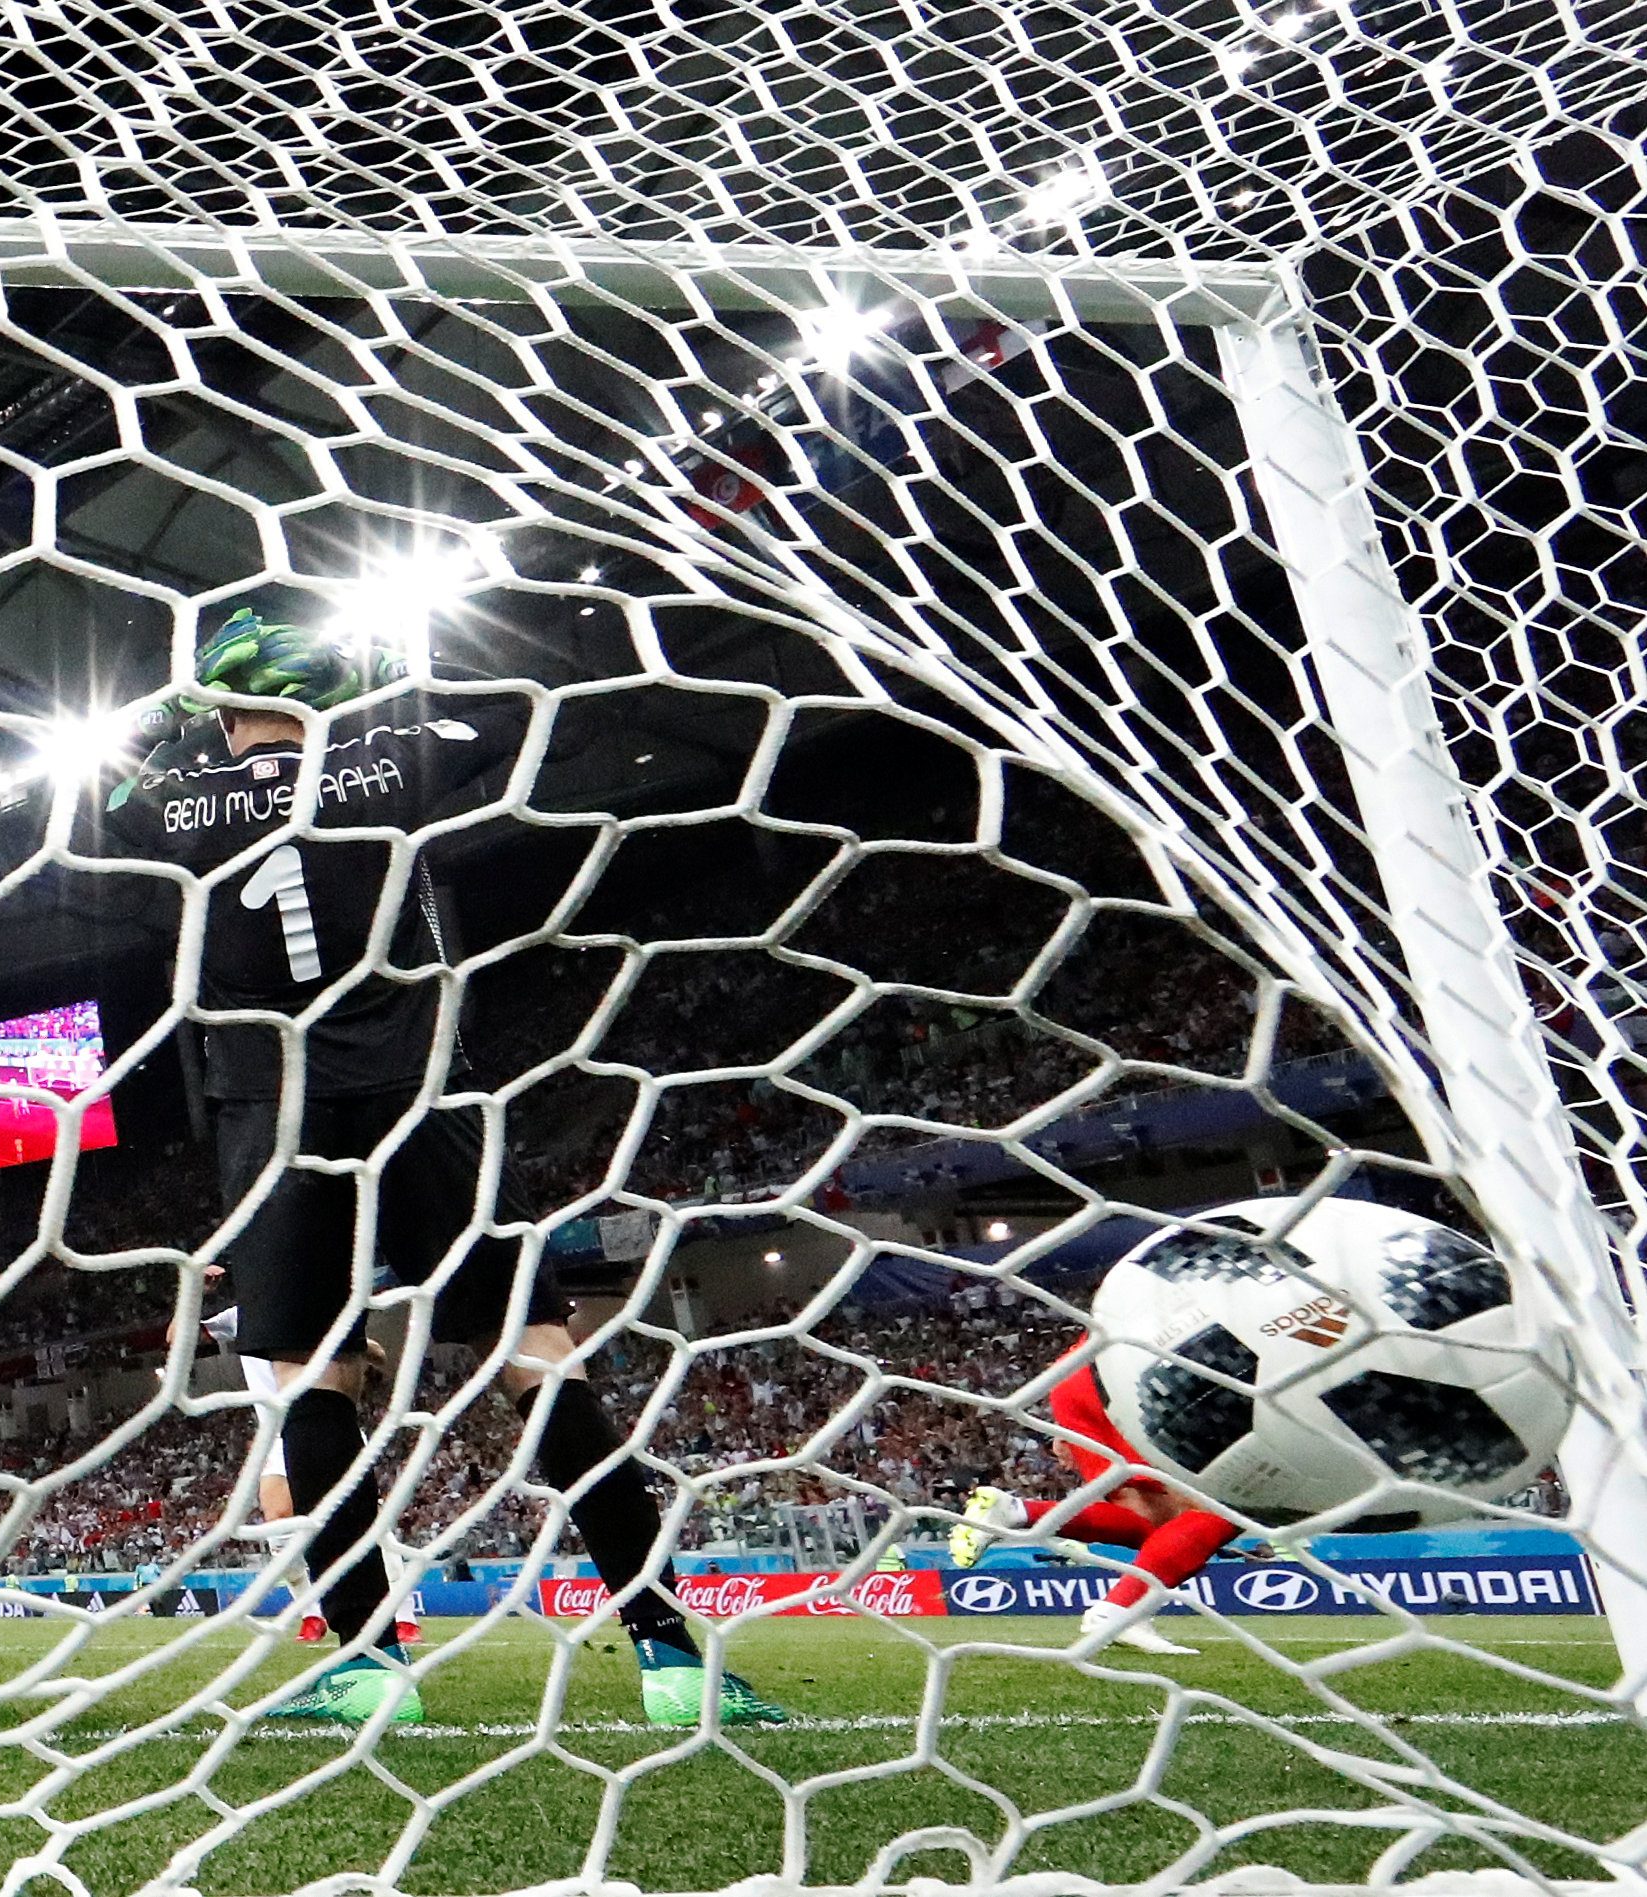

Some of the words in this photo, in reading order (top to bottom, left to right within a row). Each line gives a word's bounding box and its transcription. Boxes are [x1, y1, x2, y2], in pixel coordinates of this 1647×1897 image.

[164, 795, 216, 833] BEN
[225, 757, 403, 825] MUSAPHA
[240, 845, 322, 983] 1
[1259, 1289, 1349, 1338] didas
[1025, 1576, 1216, 1607] HYUAI
[1331, 1569, 1581, 1604] HYUNDAI
